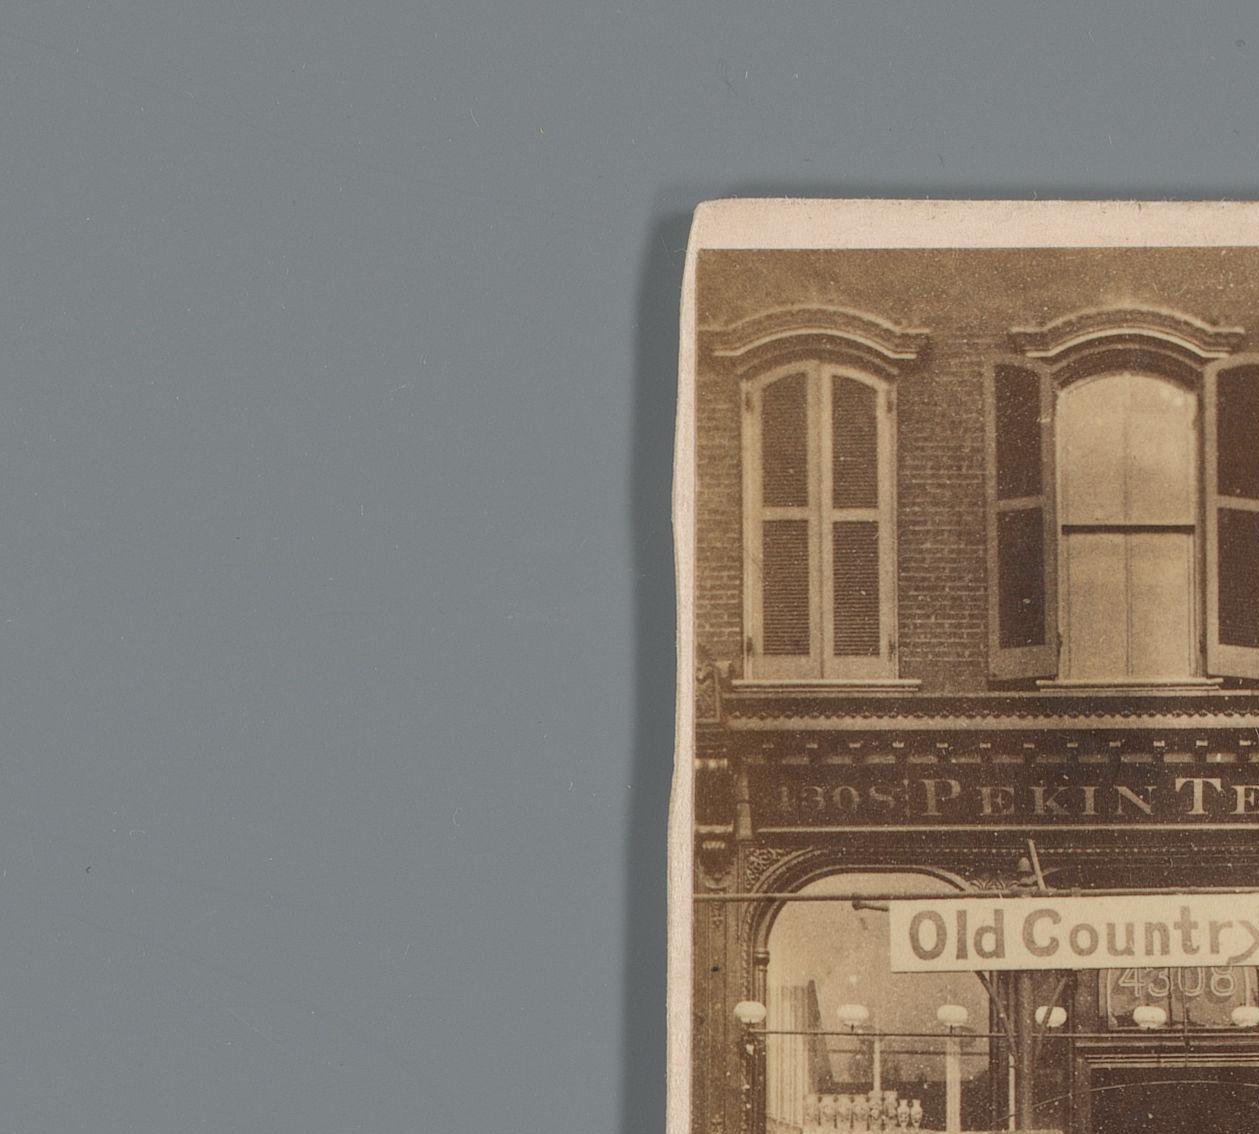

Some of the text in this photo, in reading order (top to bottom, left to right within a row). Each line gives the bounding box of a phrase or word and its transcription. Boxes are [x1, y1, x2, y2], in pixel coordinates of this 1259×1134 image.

[920, 778, 1156, 817] PEKIN
[908, 907, 1006, 962] Old
[1117, 967, 1238, 998] 4308
